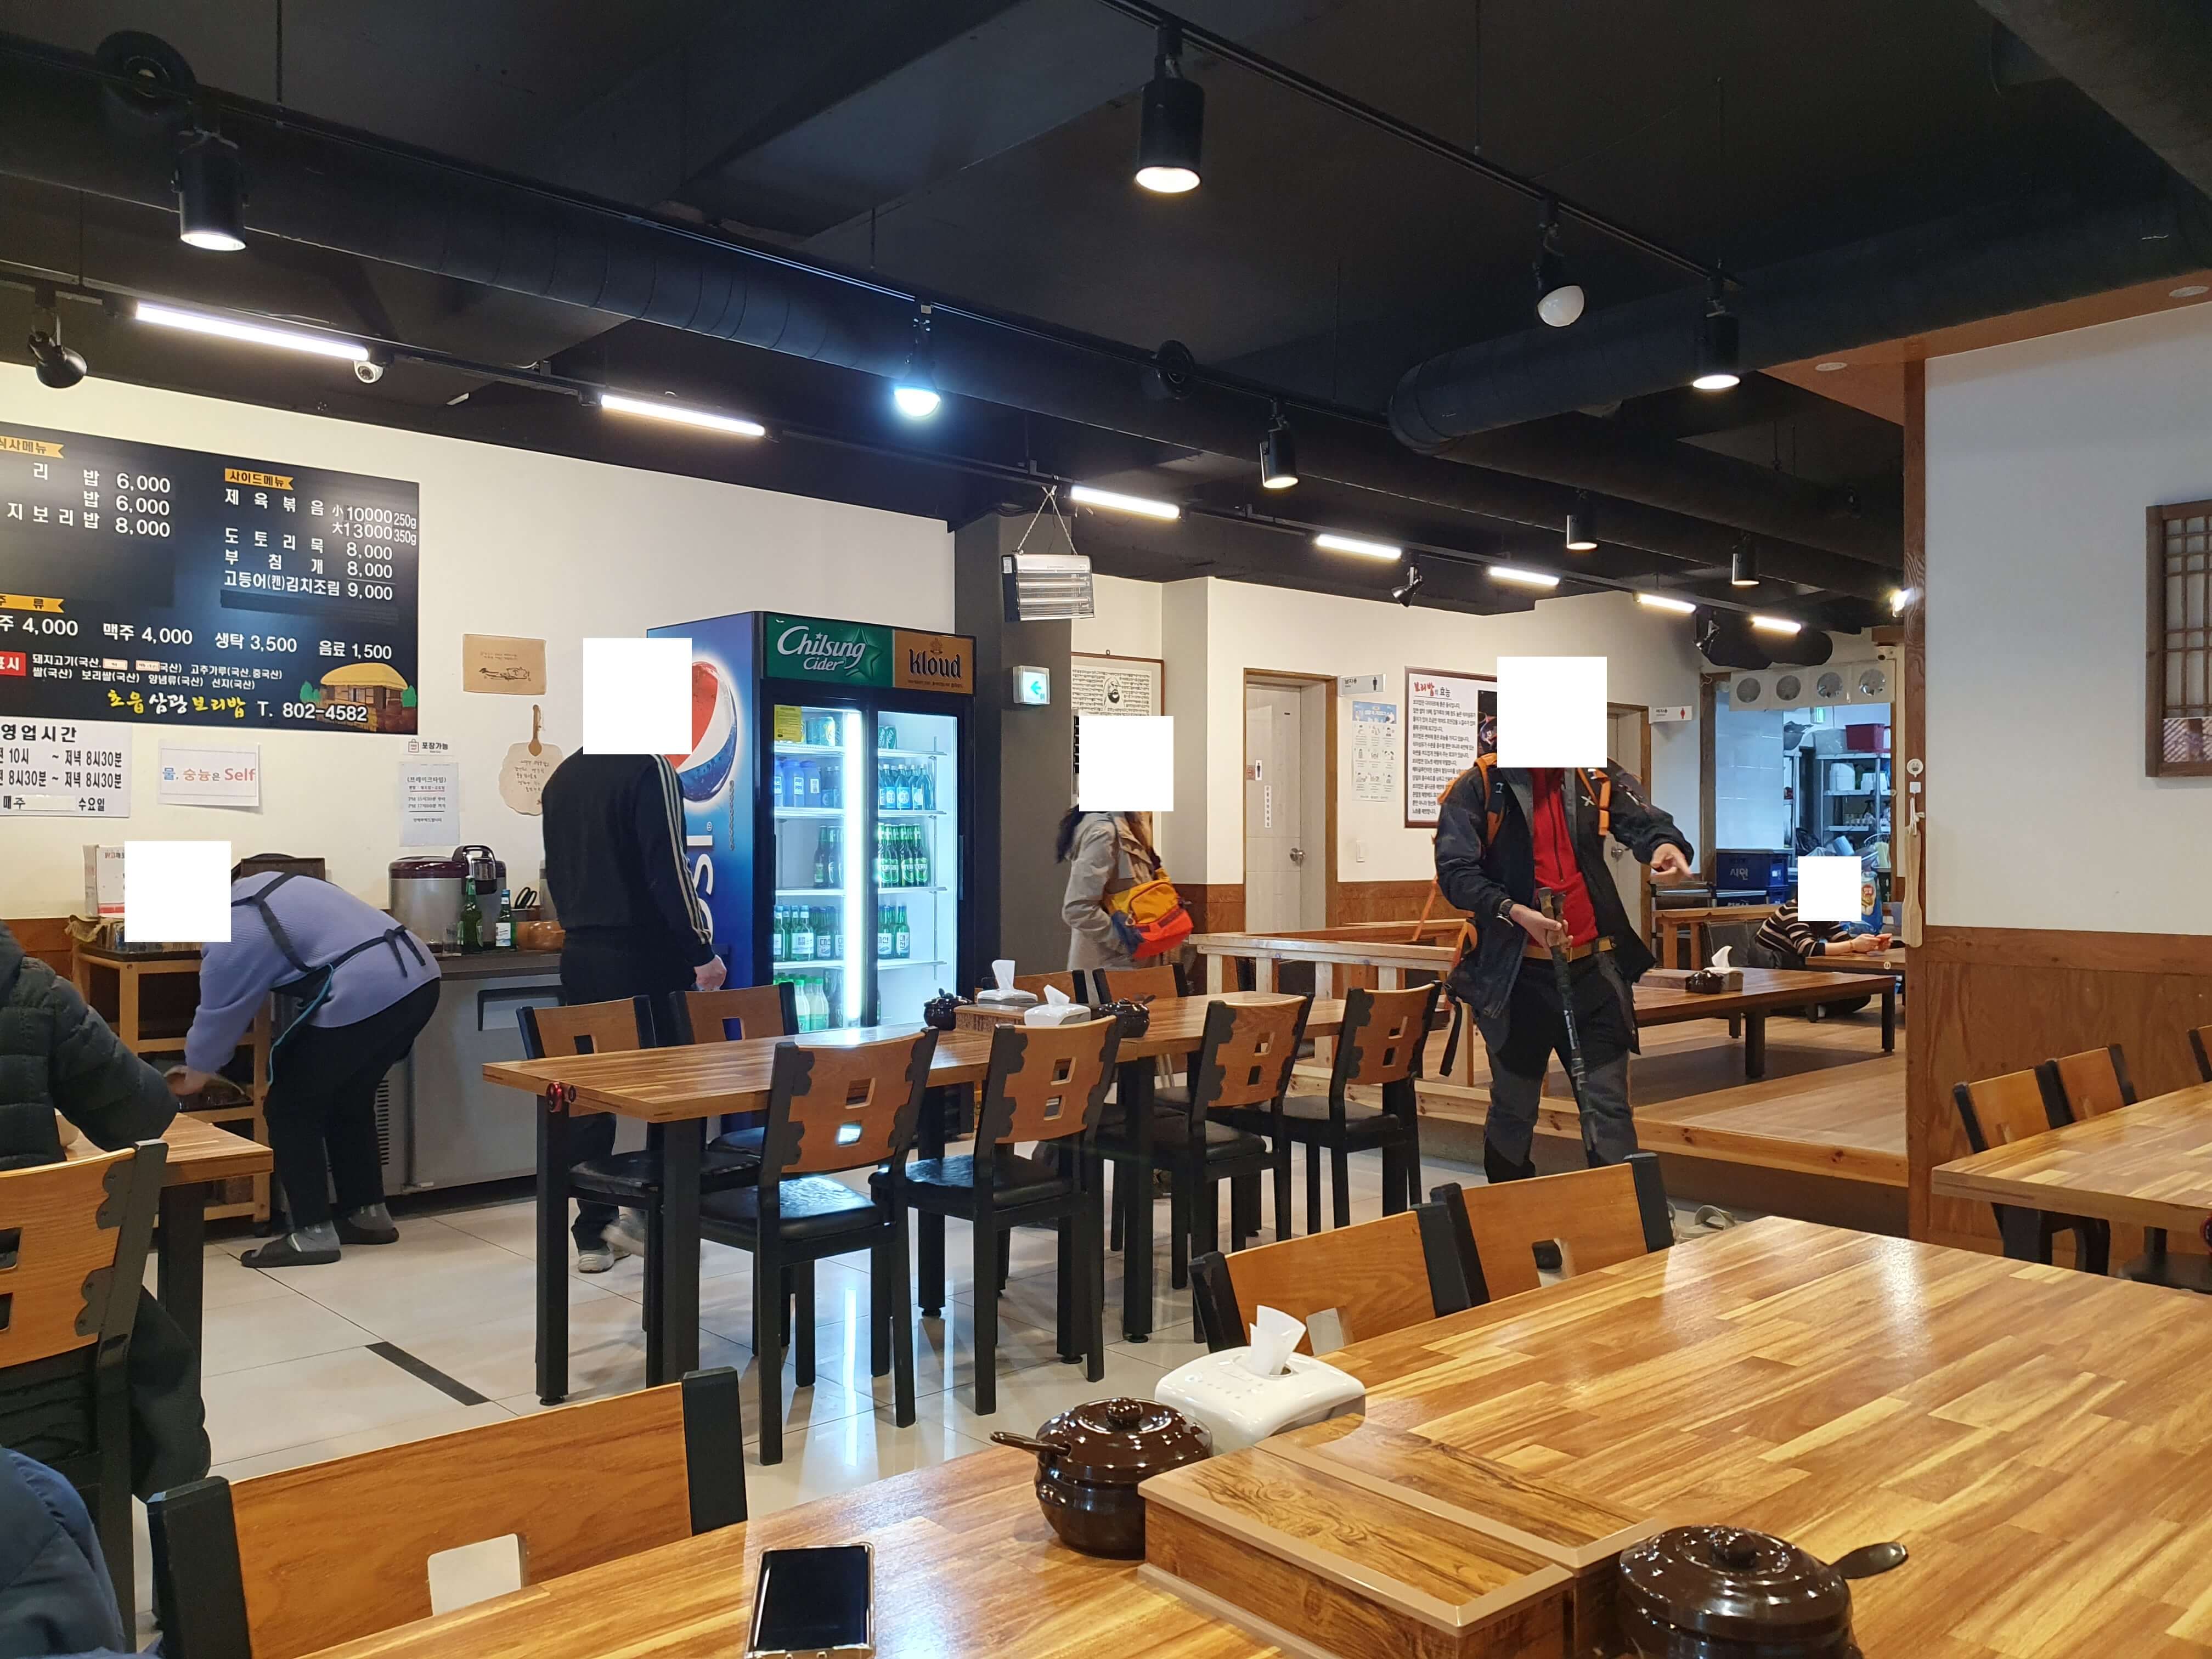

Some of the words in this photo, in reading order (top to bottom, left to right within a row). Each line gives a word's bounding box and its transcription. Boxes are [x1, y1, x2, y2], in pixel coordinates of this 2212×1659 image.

[116, 472, 171, 493] 6,000
[230, 471, 284, 488] 사이드메뉴
[116, 495, 170, 516] 6,000
[115, 517, 171, 538] 8,000
[393, 512, 417, 529] 250g
[394, 529, 417, 546] 350g
[346, 541, 392, 561] 8,000
[347, 561, 392, 579] 8,000
[347, 582, 392, 601] 9,000
[22, 617, 78, 636] 4,000
[103, 623, 135, 641] 맥주
[141, 627, 193, 645] 4,000
[215, 632, 245, 650] 생탁
[250, 635, 297, 653] 3,500
[318, 640, 346, 657] 음료
[352, 643, 392, 659] 1,500
[777, 625, 866, 669] Chilsung
[803, 657, 844, 671] Cider
[257, 701, 273, 718] T.
[283, 702, 368, 722] 802-4582
[9, 748, 29, 765] 10시
[65, 750, 81, 767] 저녁
[86, 751, 122, 768] 8시30분
[9, 770, 46, 788] 8시30분
[65, 772, 81, 789] 저녁
[86, 773, 122, 789] 8시30분
[224, 768, 256, 781] Self
[78, 797, 105, 812] 수요일
